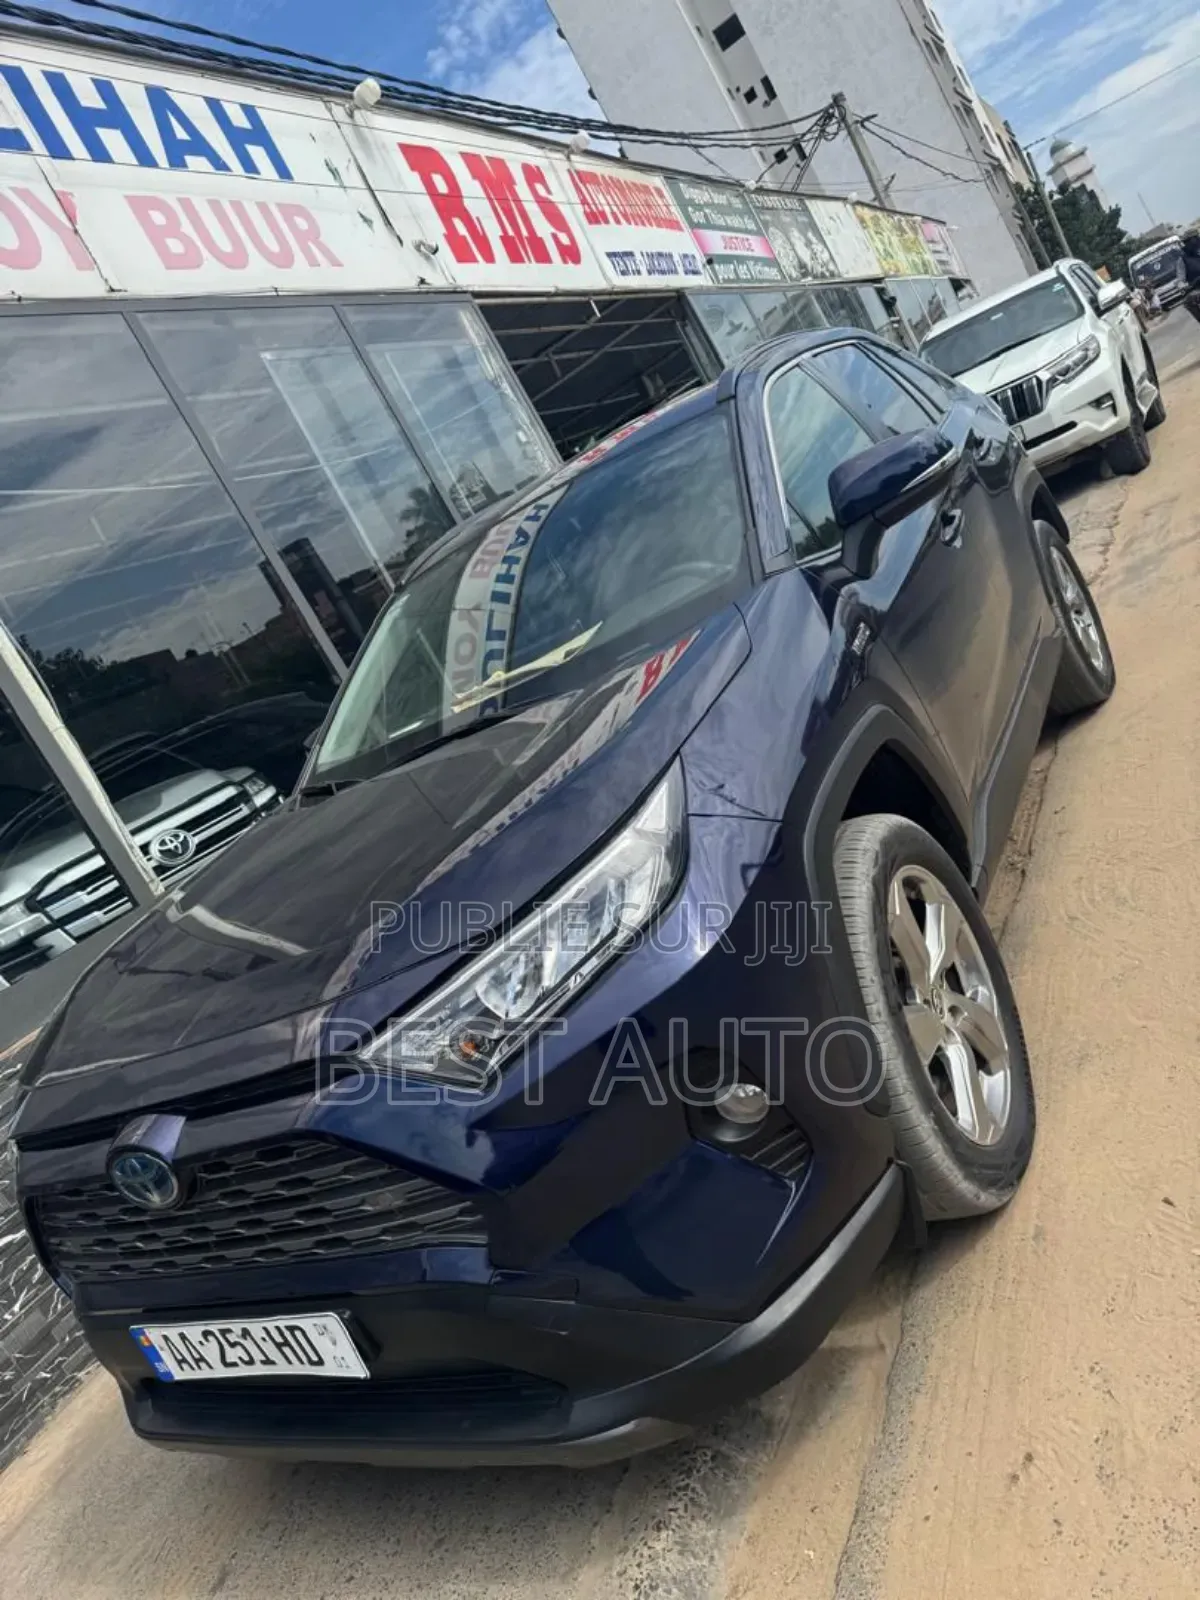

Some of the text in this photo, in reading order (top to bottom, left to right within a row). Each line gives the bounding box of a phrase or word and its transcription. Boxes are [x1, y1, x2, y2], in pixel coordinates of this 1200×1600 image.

[0, 64, 295, 182] IHAH
[124, 195, 344, 271] BUUR
[397, 142, 582, 265] RMS
